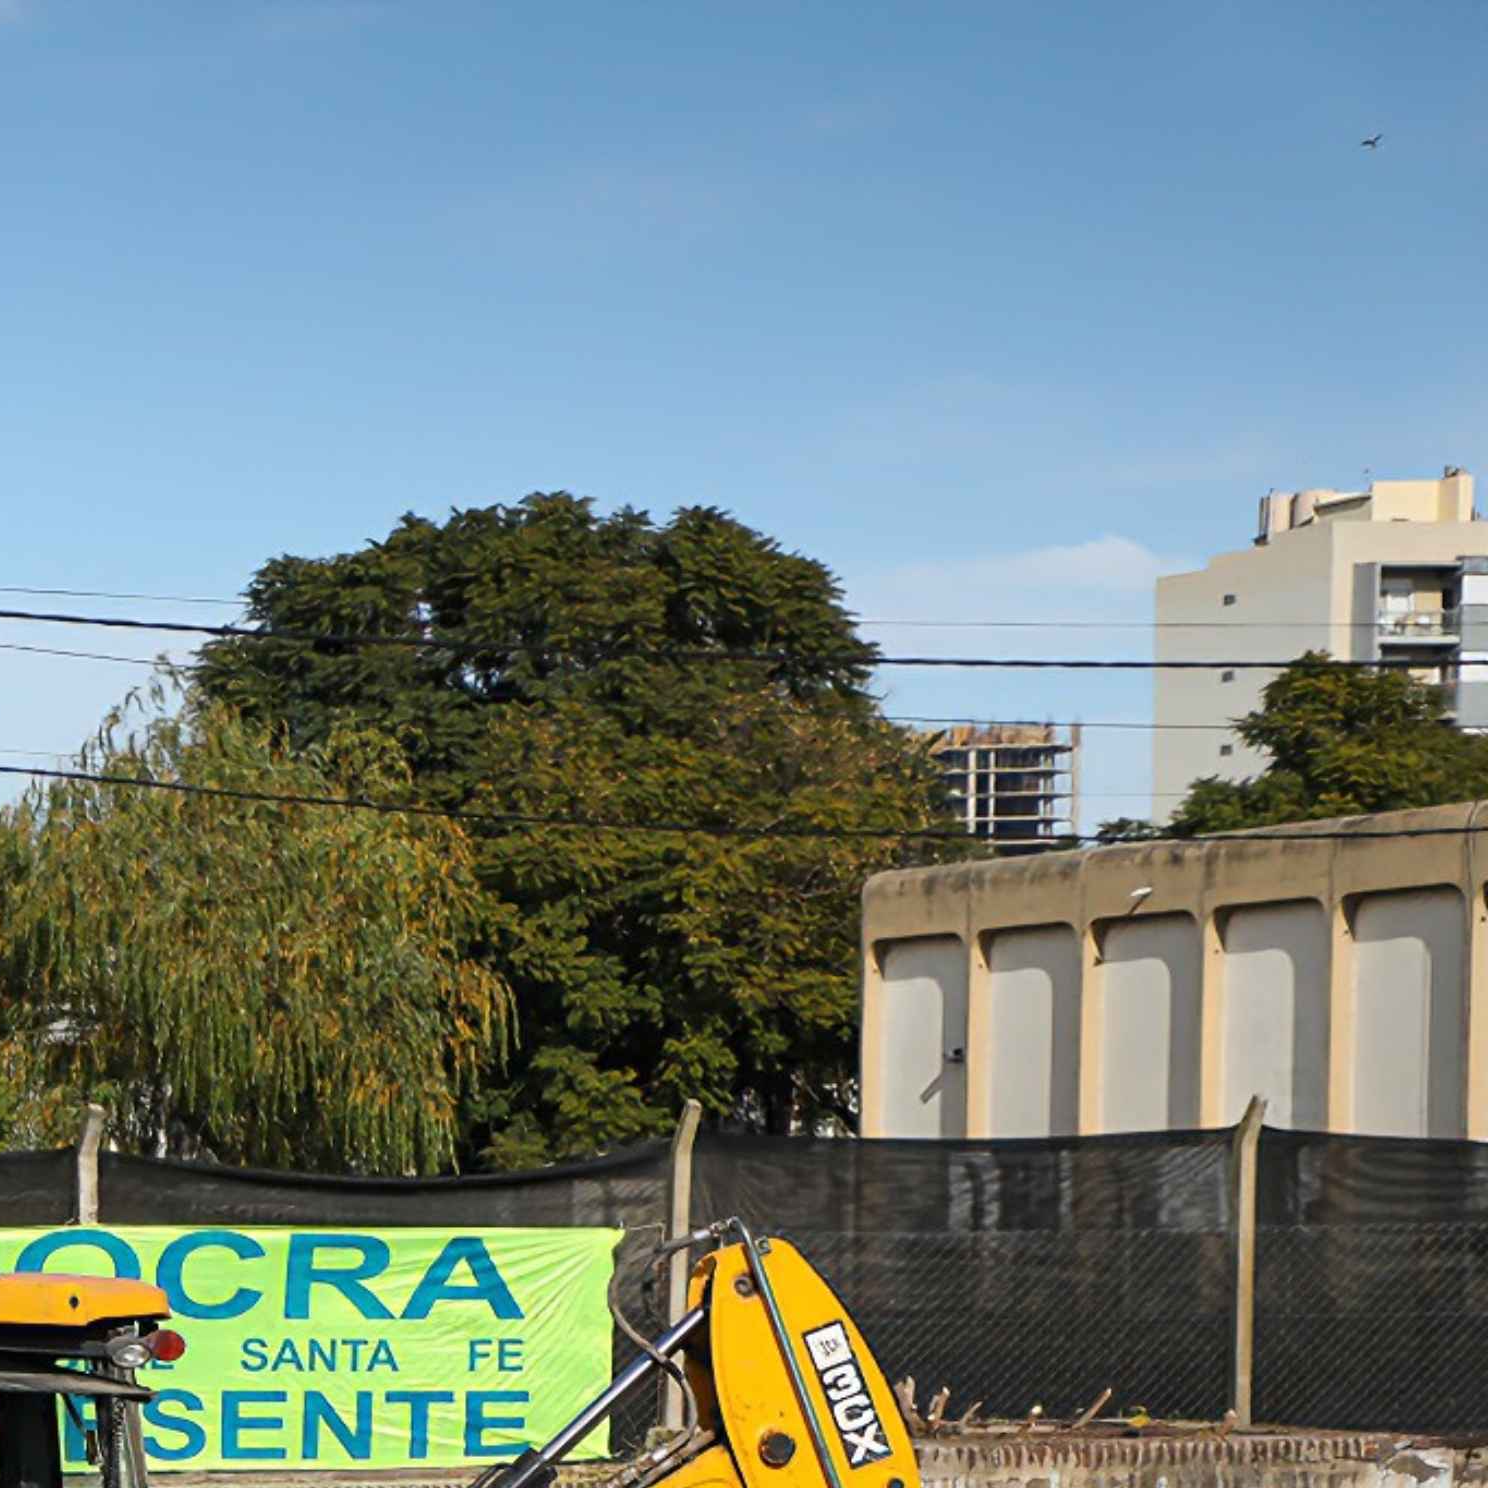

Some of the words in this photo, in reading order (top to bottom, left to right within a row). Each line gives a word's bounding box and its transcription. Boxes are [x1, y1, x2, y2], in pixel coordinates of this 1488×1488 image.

[241, 1338, 400, 1373] SANTA
[468, 1339, 525, 1373] FE
[821, 1361, 892, 1465] 3CX
